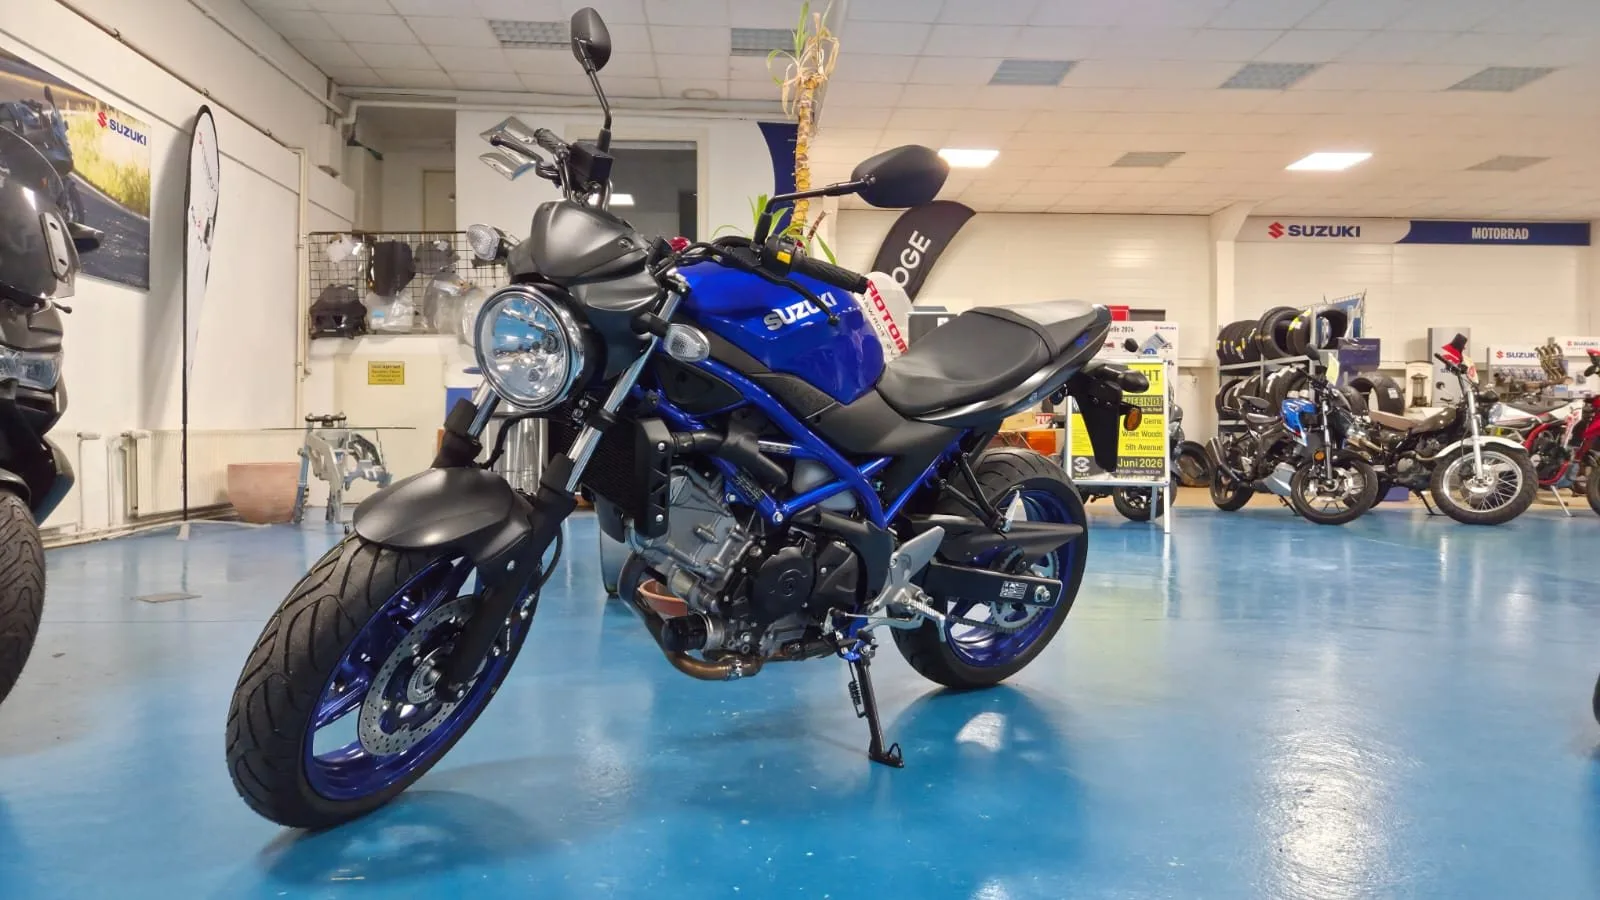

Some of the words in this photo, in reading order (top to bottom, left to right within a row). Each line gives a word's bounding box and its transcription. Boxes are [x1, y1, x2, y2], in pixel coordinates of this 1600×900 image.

[109, 118, 147, 146] SUZUKI
[1288, 225, 1361, 237] SUZUKI
[1471, 227, 1529, 240] MOTORRAD
[891, 230, 931, 288] OGE
[763, 291, 838, 331] SUZUKI
[1117, 458, 1138, 468] Juni
[1139, 458, 1163, 468] 2026
